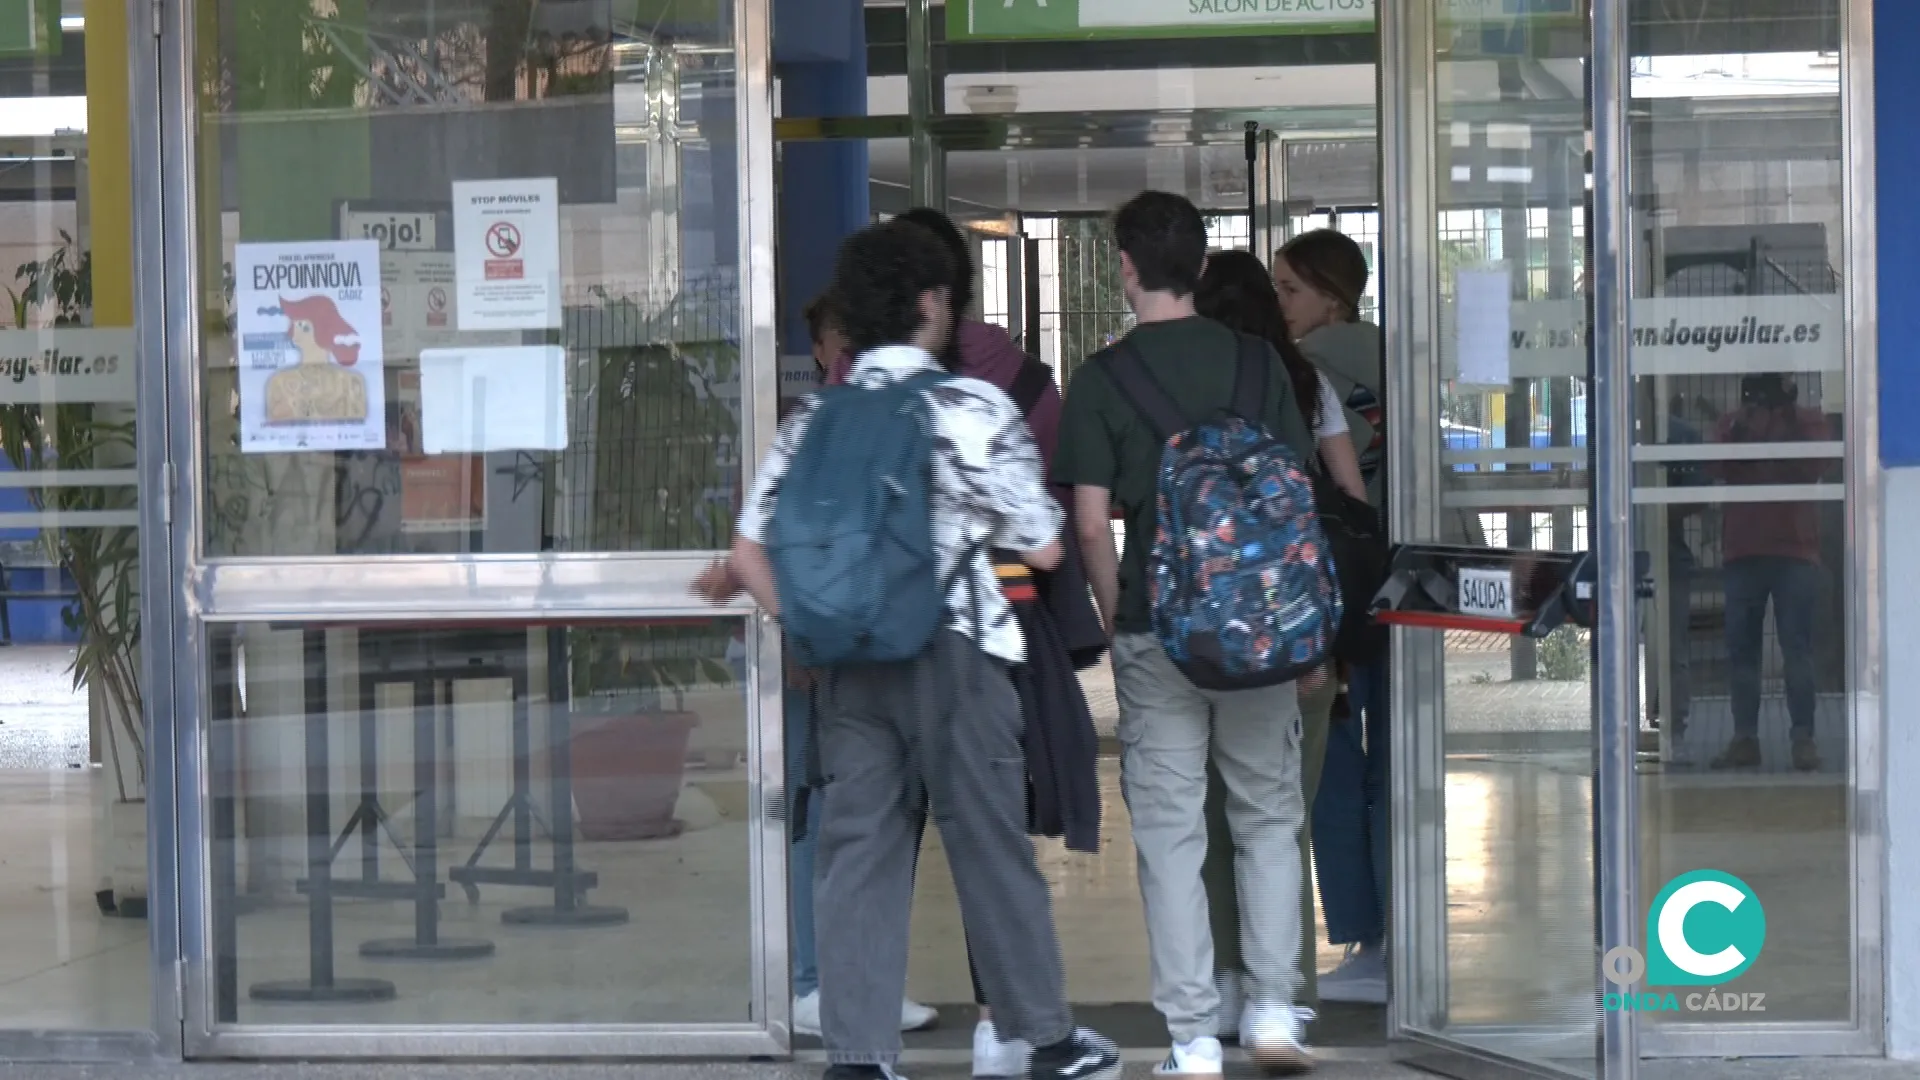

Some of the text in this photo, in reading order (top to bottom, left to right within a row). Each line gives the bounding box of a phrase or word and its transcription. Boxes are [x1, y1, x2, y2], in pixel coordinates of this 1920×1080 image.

[1266, 0, 1292, 11] DE
[471, 193, 541, 205] STOP MÓVILES
[253, 261, 362, 290] EXPOINNOVA
[1463, 579, 1506, 610] SALIDA
